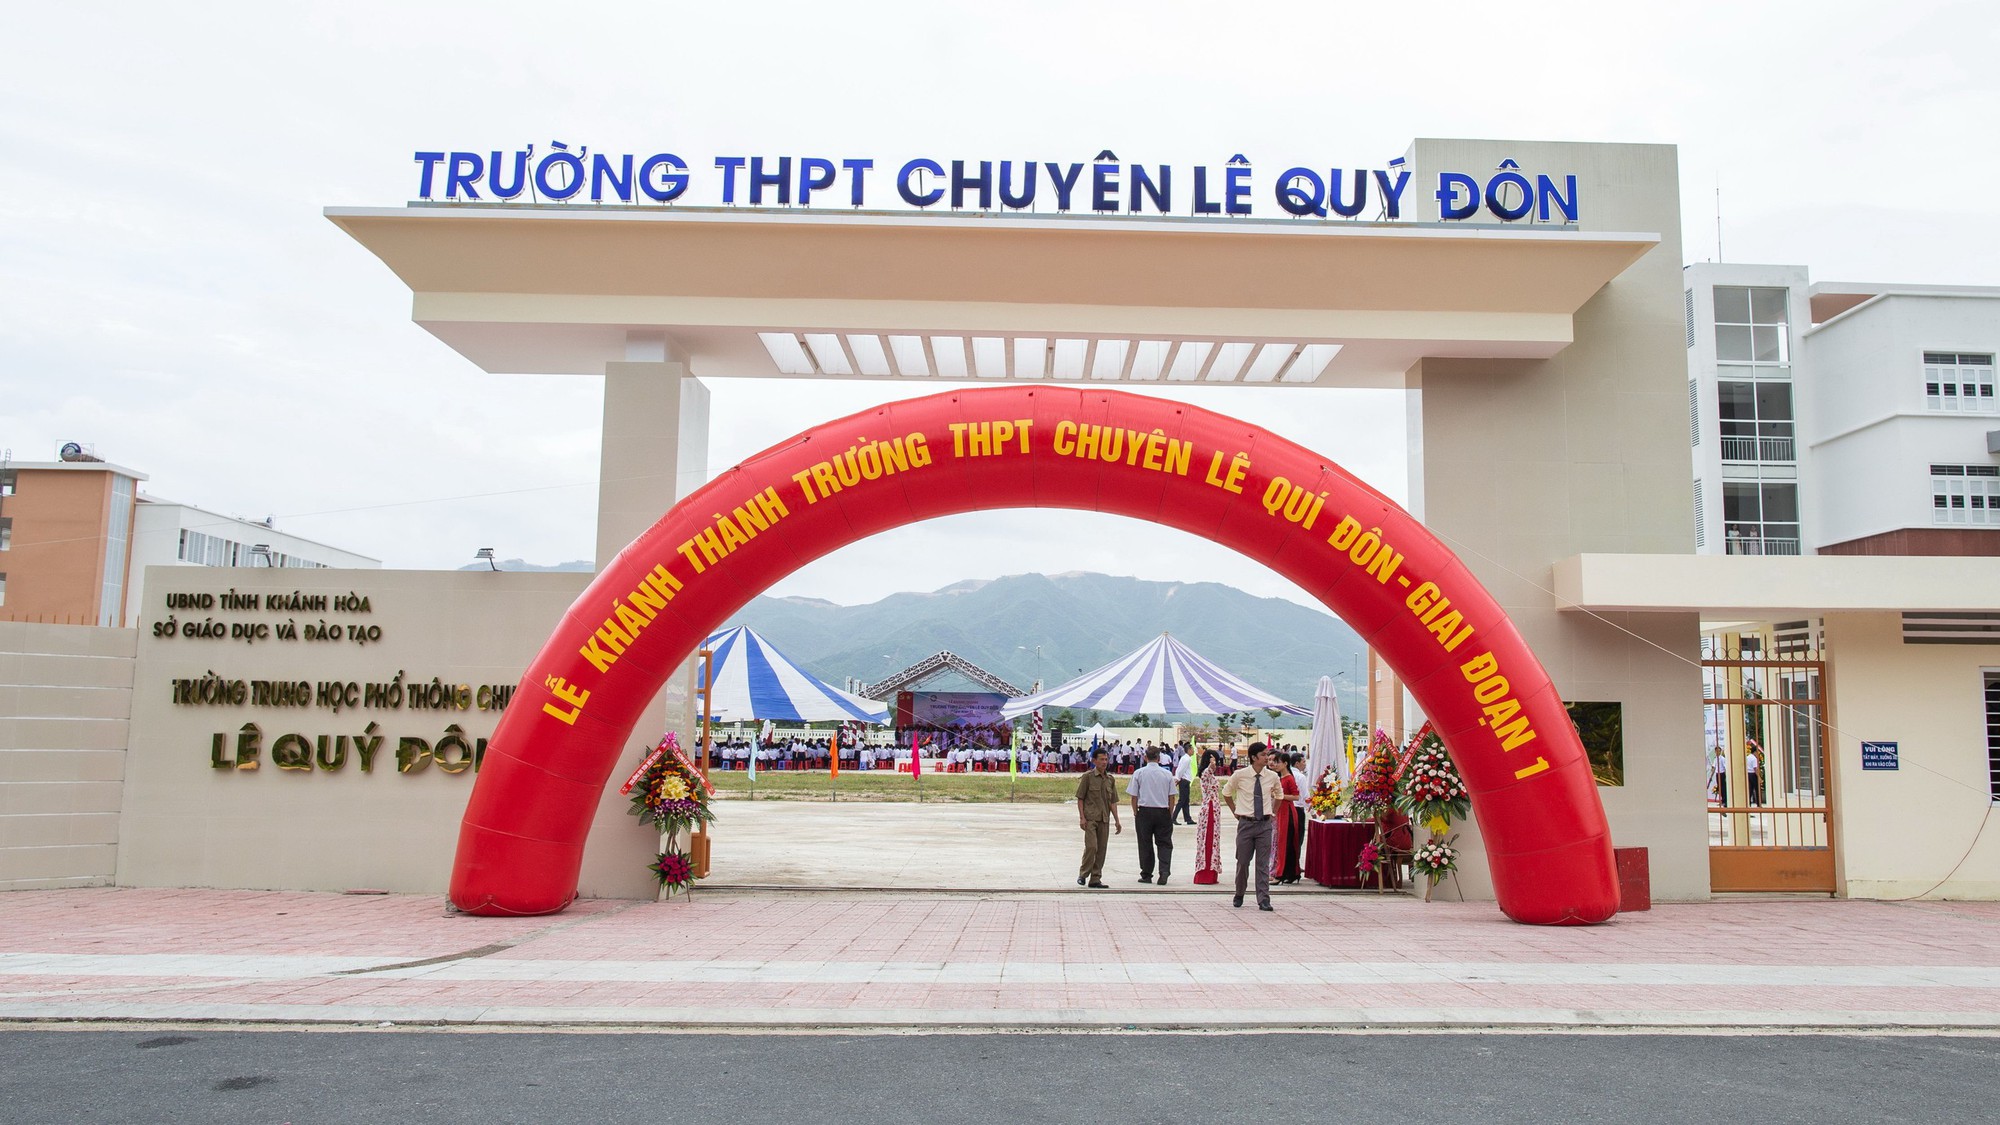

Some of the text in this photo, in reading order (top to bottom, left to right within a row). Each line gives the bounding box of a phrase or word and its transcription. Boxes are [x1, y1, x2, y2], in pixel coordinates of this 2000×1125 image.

[413, 140, 1579, 222] TRƯỜNG THPT CHUYÊN LÊ QUÝ ĐÔN
[166, 588, 372, 612] UBND TỈNH KHÁNH HÒA
[542, 673, 591, 726] LỄ
[578, 563, 684, 674] KHÁNH
[676, 485, 790, 574] THÀNH
[792, 432, 932, 505] TRƯỜNG
[949, 419, 1034, 458] THPT
[1053, 420, 1194, 477] CHUYÊN
[1205, 450, 1251, 495] LÊ
[1262, 476, 1330, 531] QUÍ
[1459, 651, 1537, 752] ĐOẠN
[1514, 755, 1550, 780] 1
[153, 615, 382, 645] SỞ GIÁO DỤC VÀ ĐÀO TẠO
[172, 669, 247, 706] TRƯỜNG
[250, 680, 312, 707] TRUNG
[316, 681, 360, 713] HỌC
[364, 670, 404, 709] PHỔ
[407, 676, 472, 711] THÔNG
[211, 722, 262, 771] LÊ
[272, 721, 385, 773] QUÝ
